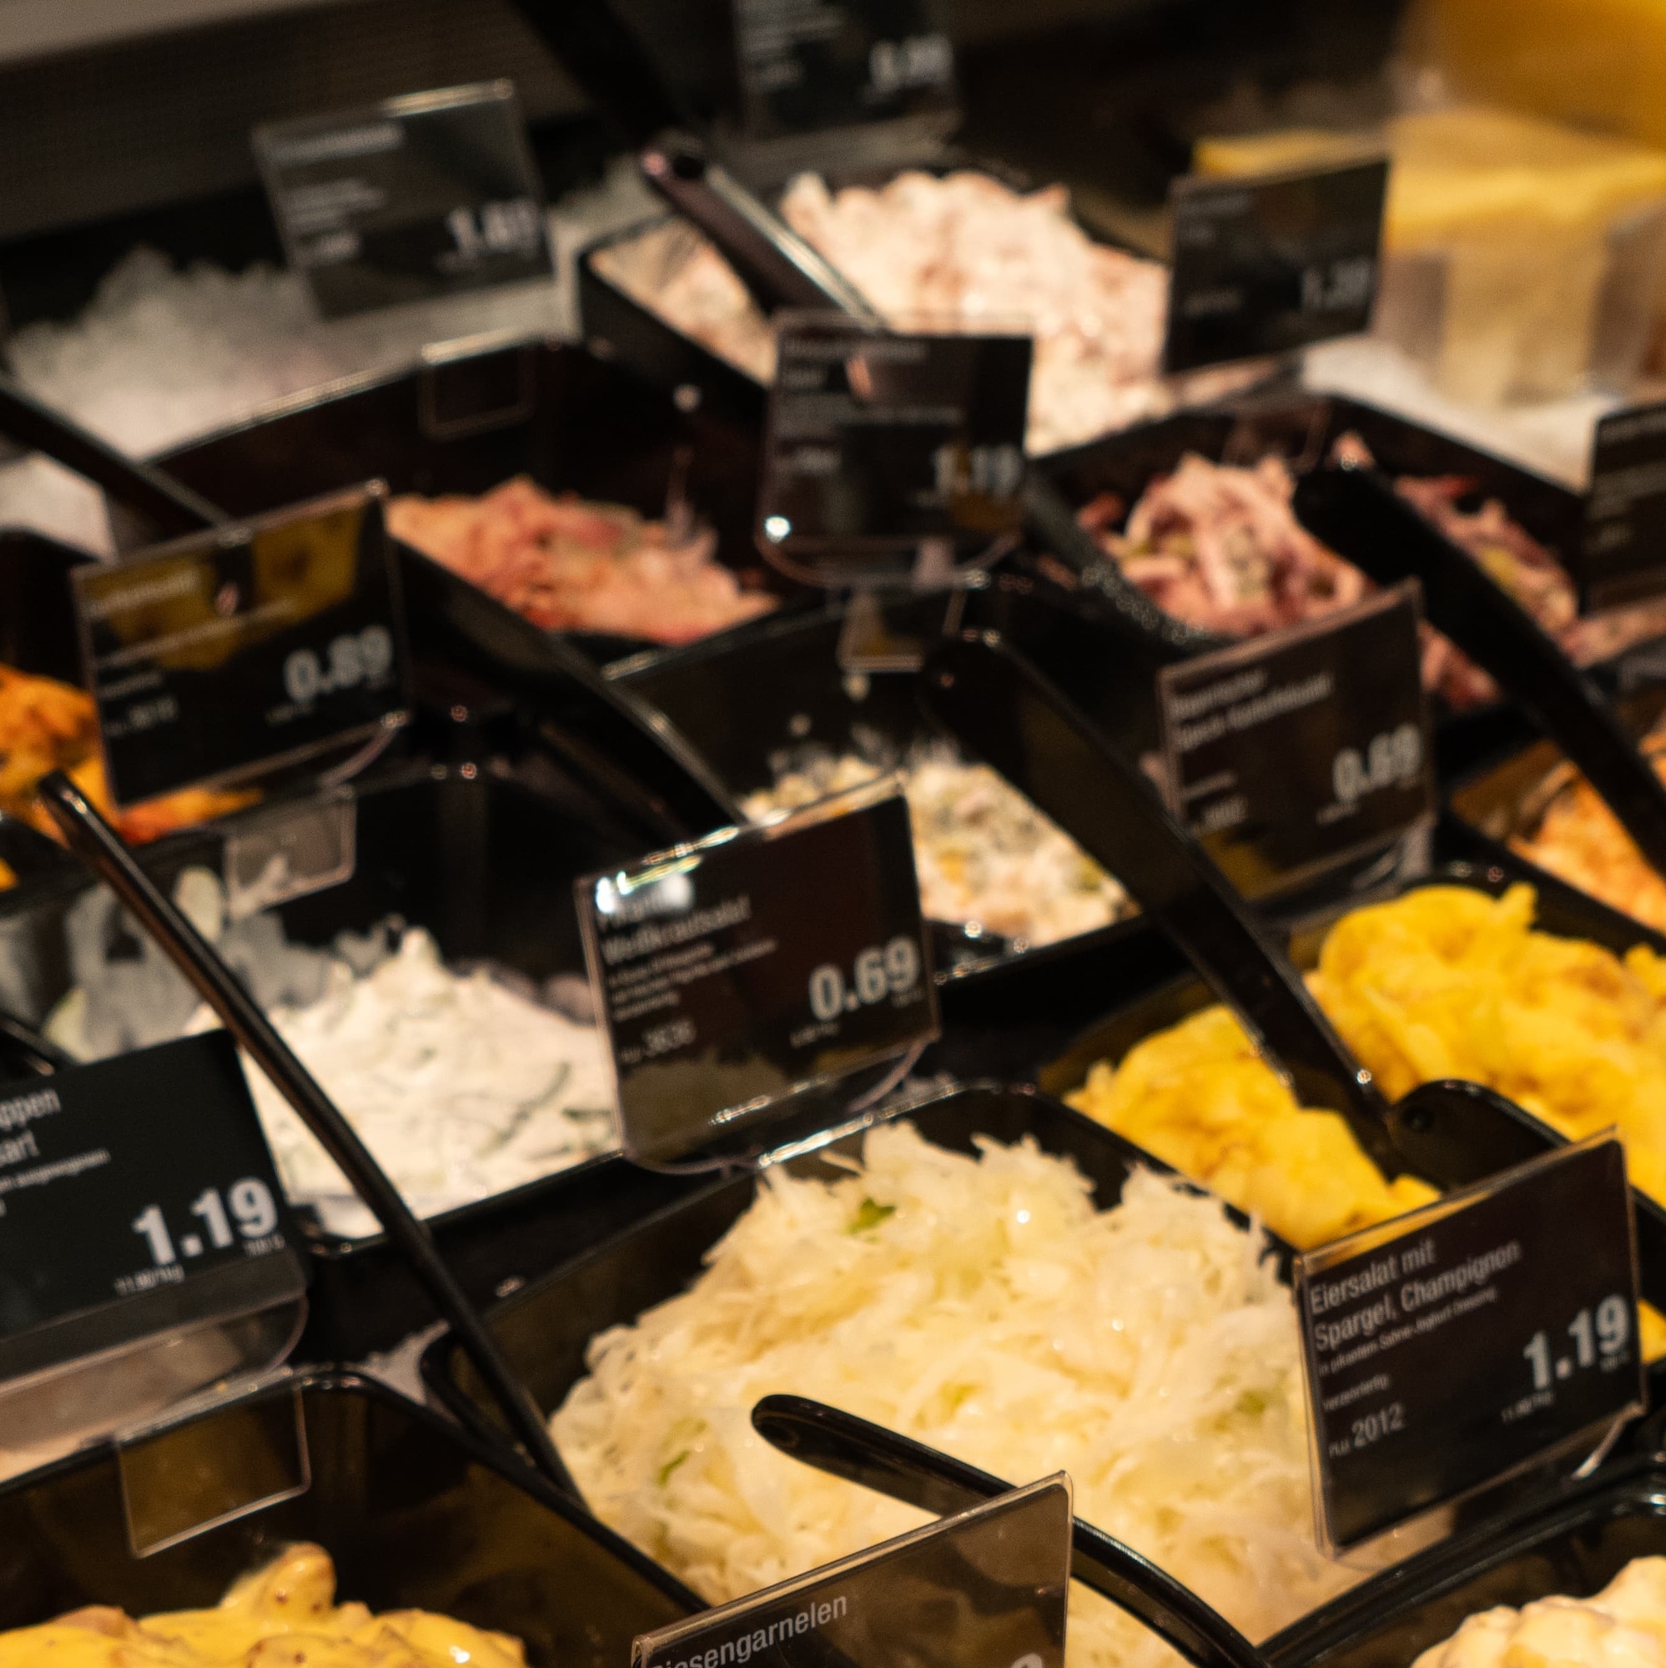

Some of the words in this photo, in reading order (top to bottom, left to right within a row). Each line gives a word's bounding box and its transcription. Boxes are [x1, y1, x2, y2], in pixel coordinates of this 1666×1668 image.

[810, 941, 918, 1018] 0.69
[133, 1180, 274, 1265] 1.19
[1309, 1255, 1396, 1314] Eiersalat
[1400, 1238, 1434, 1273] mit
[1313, 1293, 1398, 1350] Spargel,
[1399, 1243, 1518, 1312] Champignon
[1522, 1298, 1625, 1387] 1.19
[1350, 1402, 1404, 1448] 2012
